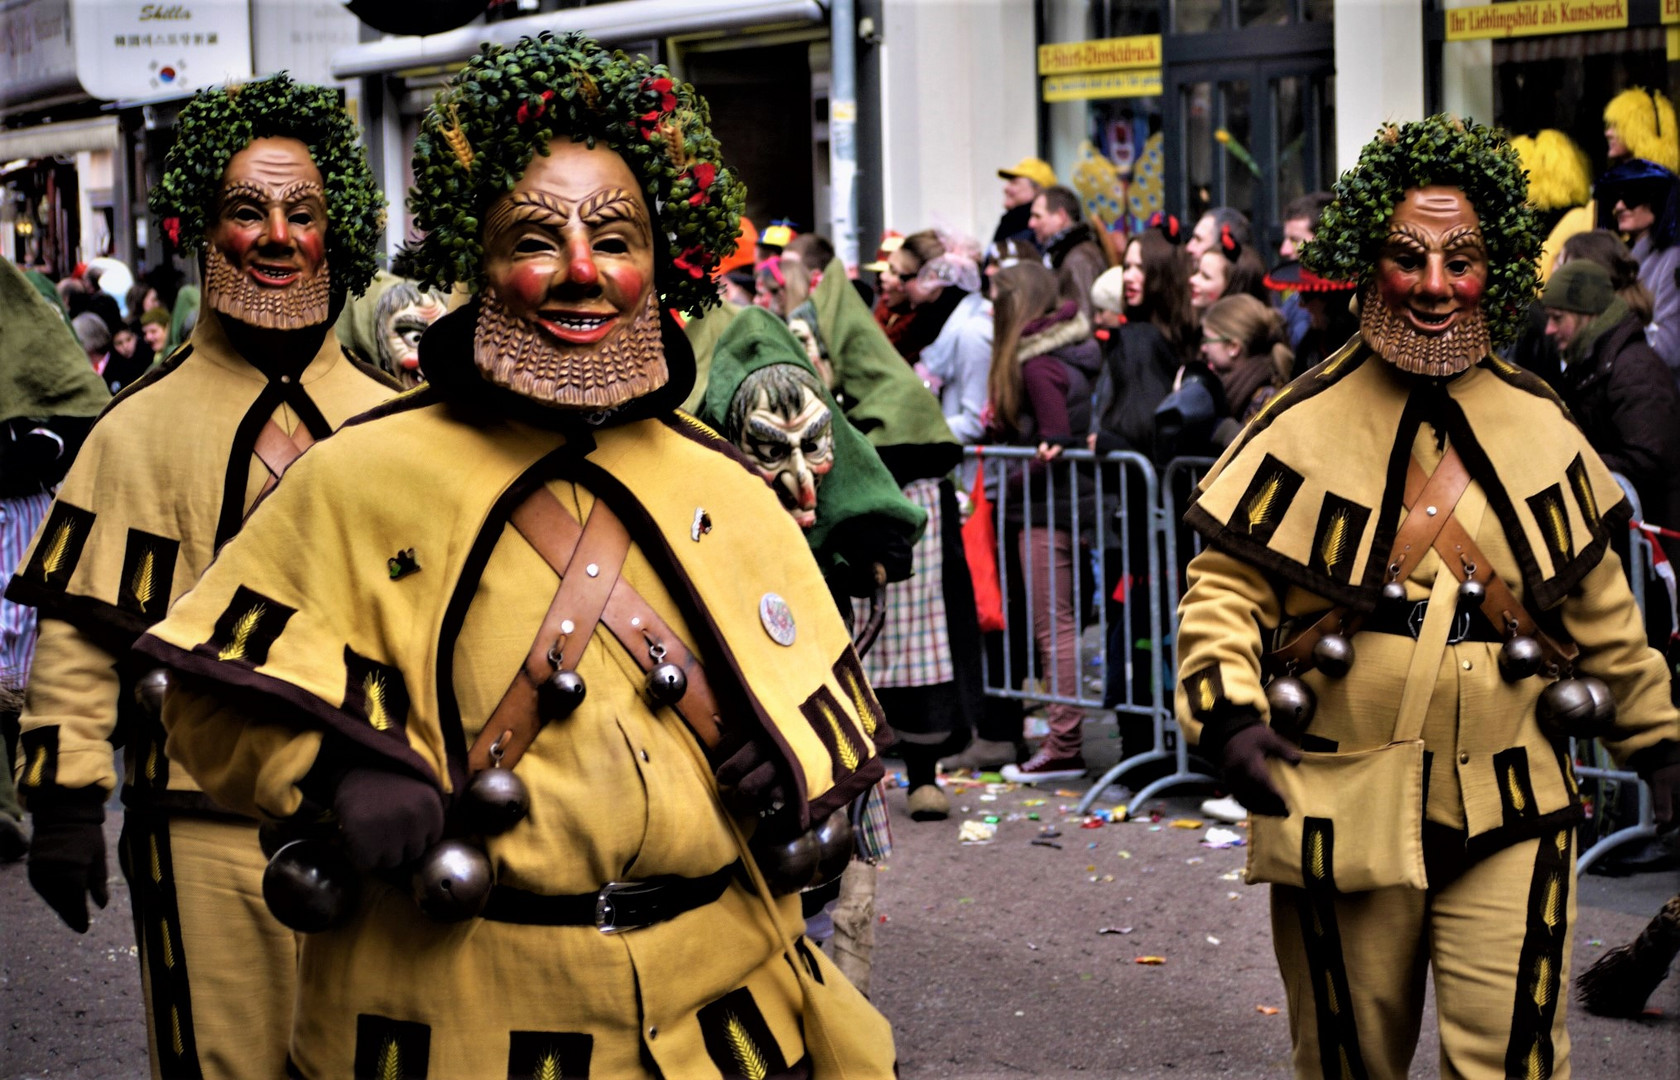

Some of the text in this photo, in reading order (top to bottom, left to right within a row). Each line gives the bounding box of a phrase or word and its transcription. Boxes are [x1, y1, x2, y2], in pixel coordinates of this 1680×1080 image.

[1450, 0, 1623, 36] Ihr Lieblingsbild als Kunstwerk
